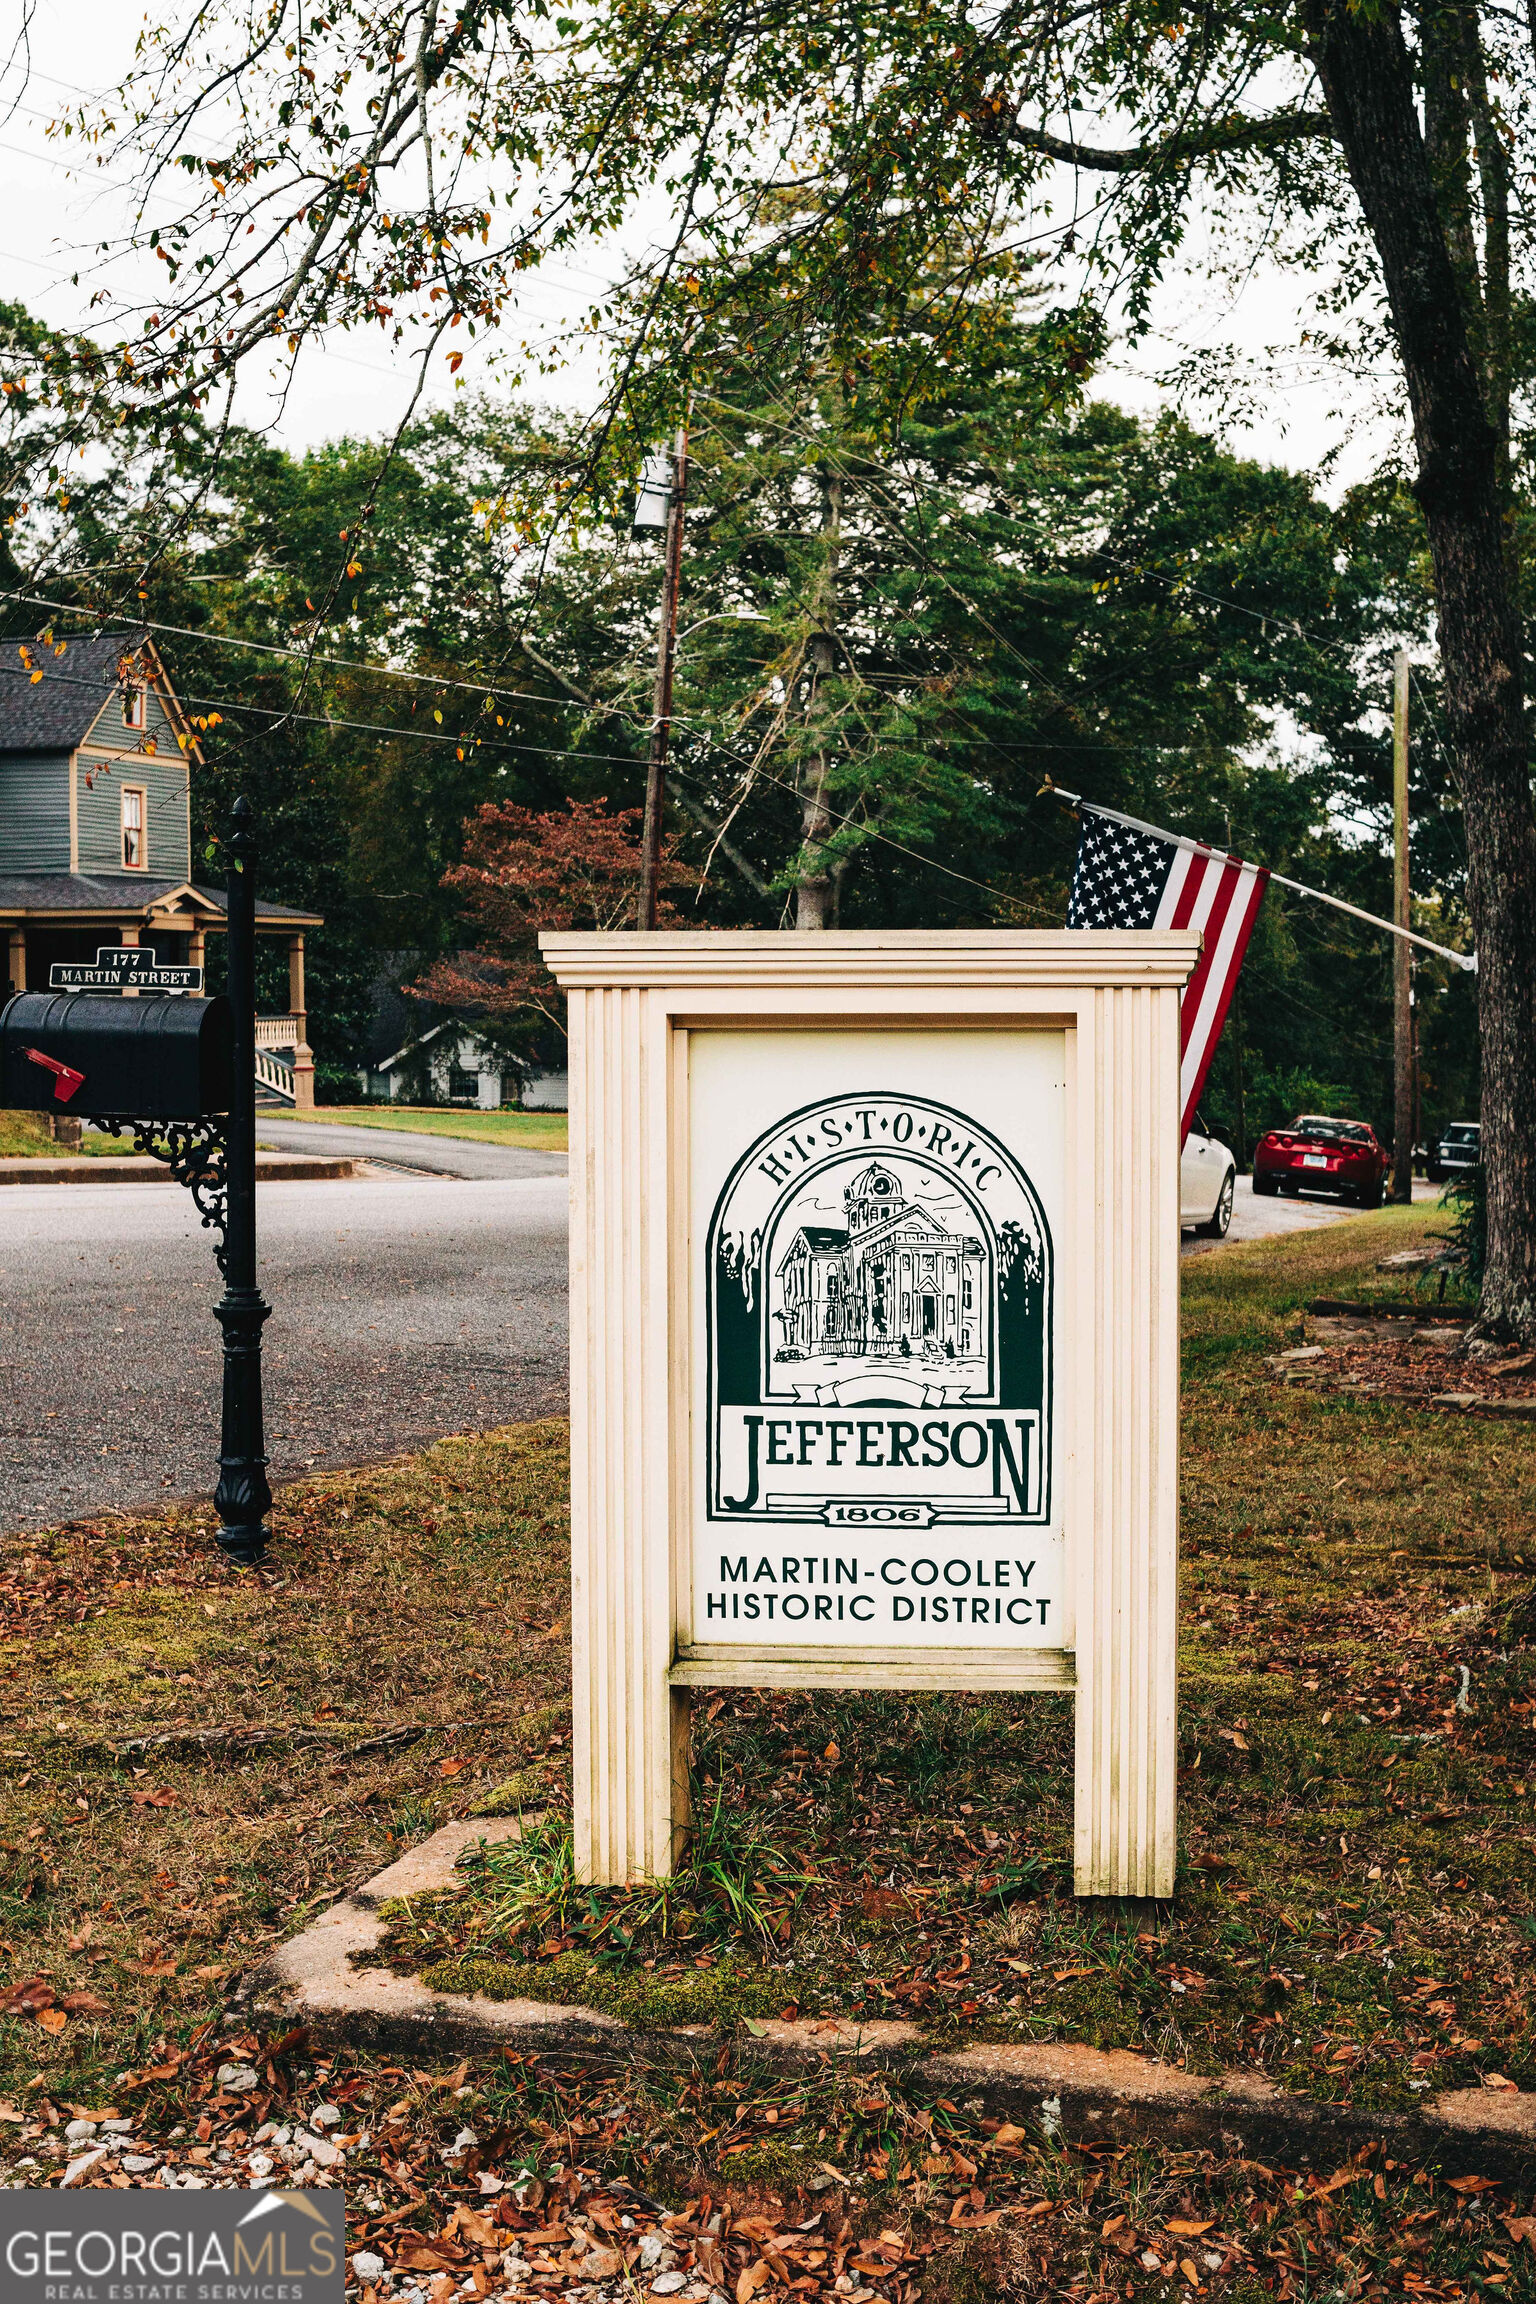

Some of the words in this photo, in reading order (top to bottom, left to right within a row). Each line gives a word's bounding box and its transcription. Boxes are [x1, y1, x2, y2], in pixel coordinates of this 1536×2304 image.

[112, 953, 140, 966] 177
[61, 969, 121, 983] MARTIN
[128, 971, 190, 985] STREET
[723, 1414, 1035, 1514] JEFFERSON
[835, 1507, 921, 1522] 1806
[720, 1556, 1036, 1588] MARTIN-COOLEY
[707, 1593, 876, 1622] HISTORIC
[893, 1596, 1051, 1626] DISTRICT
